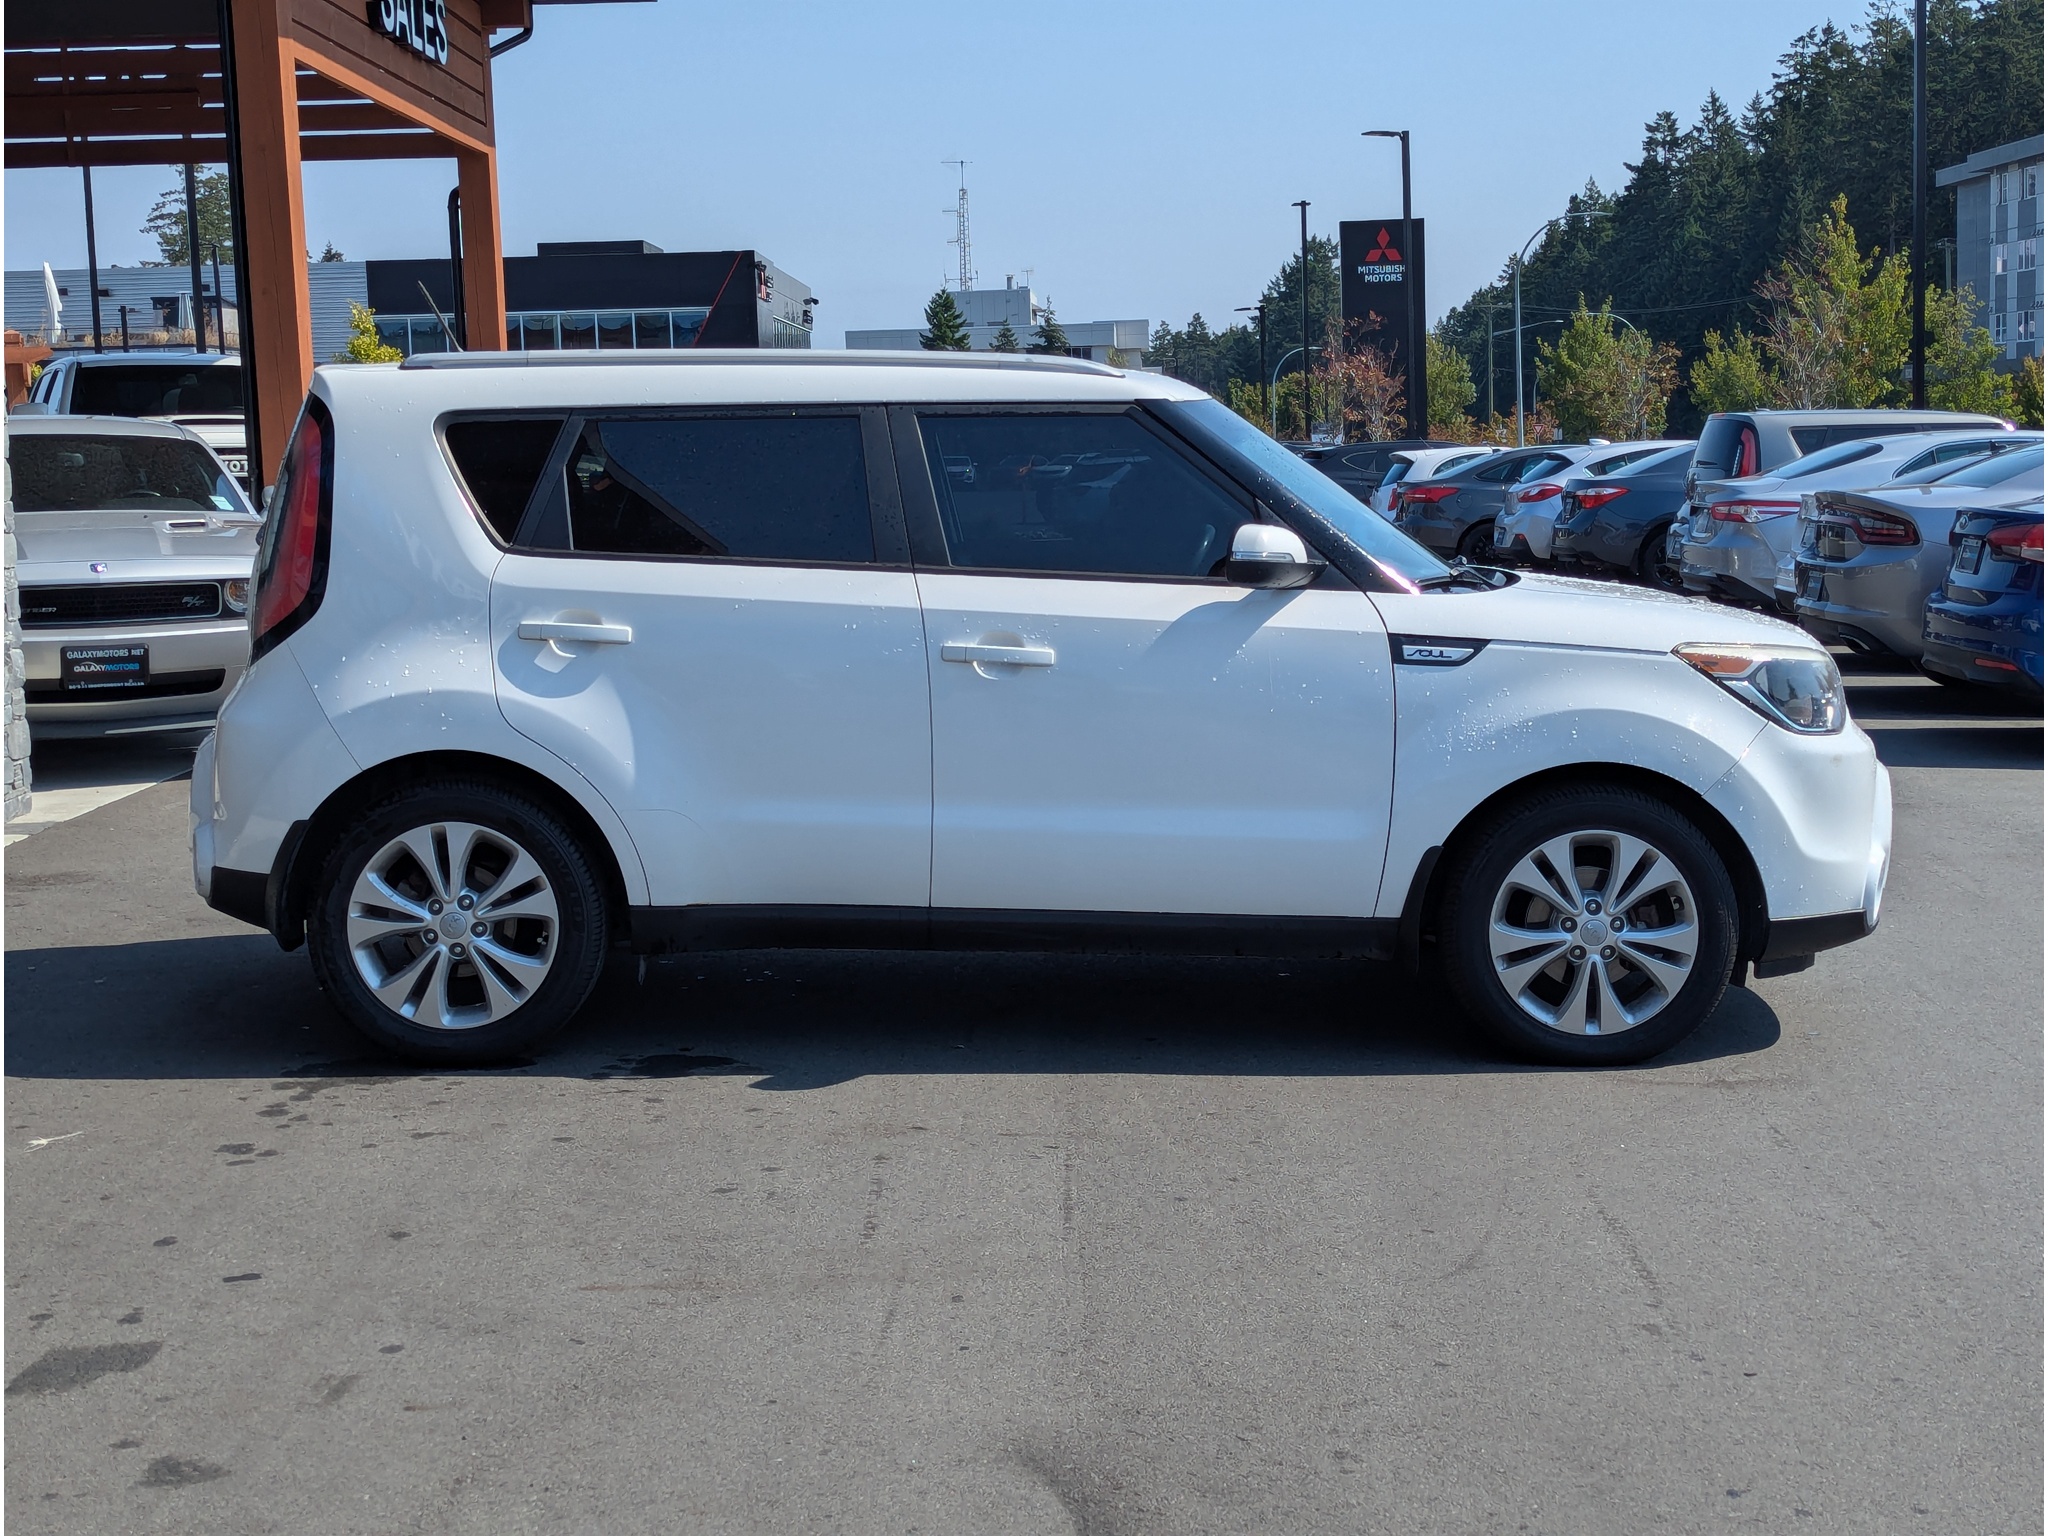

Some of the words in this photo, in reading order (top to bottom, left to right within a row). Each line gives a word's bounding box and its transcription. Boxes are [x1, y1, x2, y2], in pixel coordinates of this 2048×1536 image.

[1357, 264, 1406, 274] MITSUBISH
[1364, 273, 1403, 283] MOTORS
[1406, 648, 1453, 659] SOUL
[73, 663, 140, 673] GALAXYMOTORS
